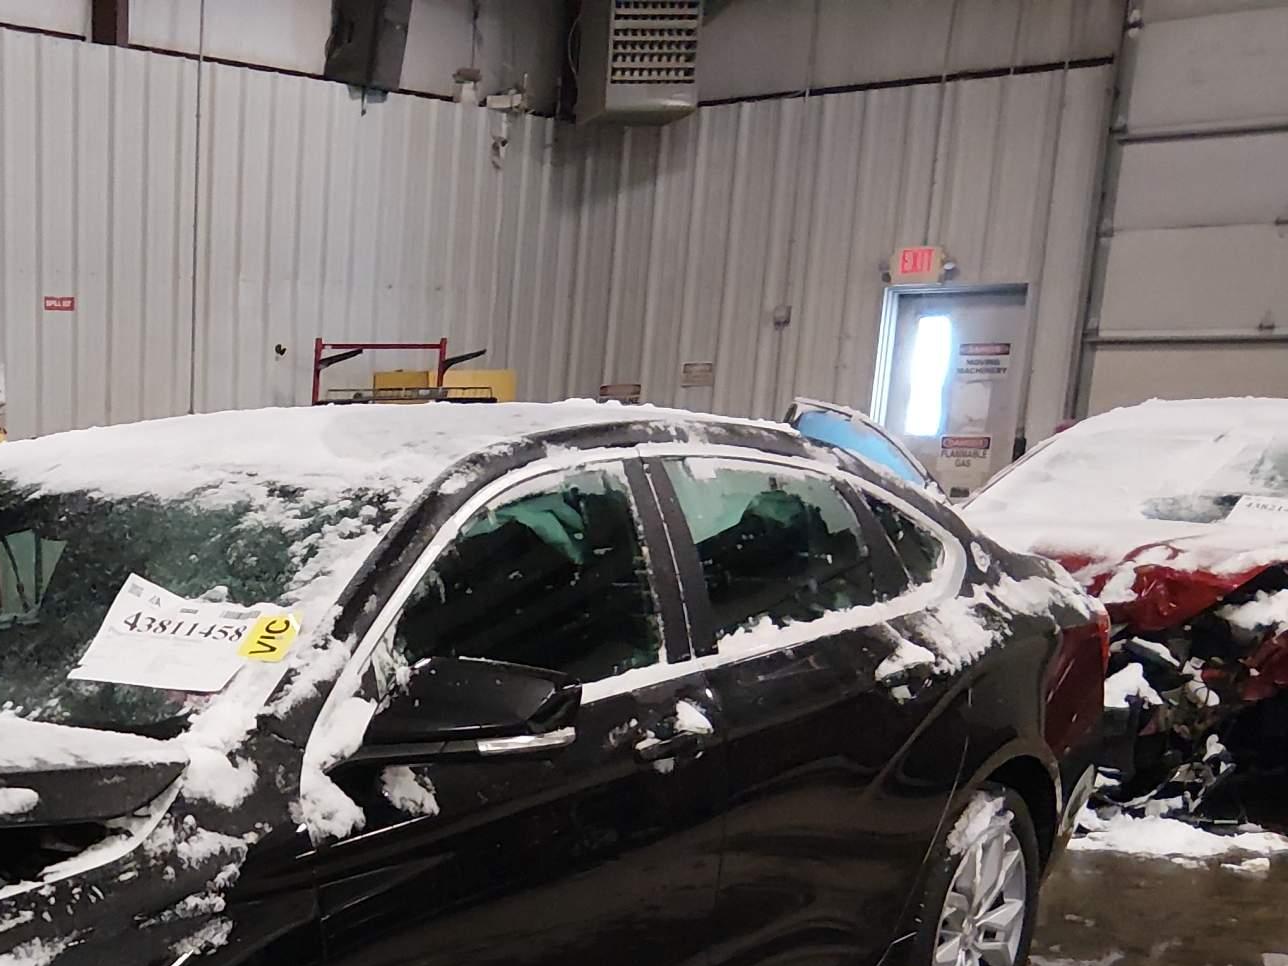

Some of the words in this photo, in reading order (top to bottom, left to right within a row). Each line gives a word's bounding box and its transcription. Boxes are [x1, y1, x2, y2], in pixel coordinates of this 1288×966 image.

[901, 248, 935, 273] EXIT
[966, 358, 1001, 366] MOVING
[956, 367, 1008, 375] MACHINERY
[941, 448, 987, 459] FLAMMABLE
[954, 458, 971, 467] GAS
[123, 611, 248, 642] 43811458
[248, 619, 290, 655] VIC
